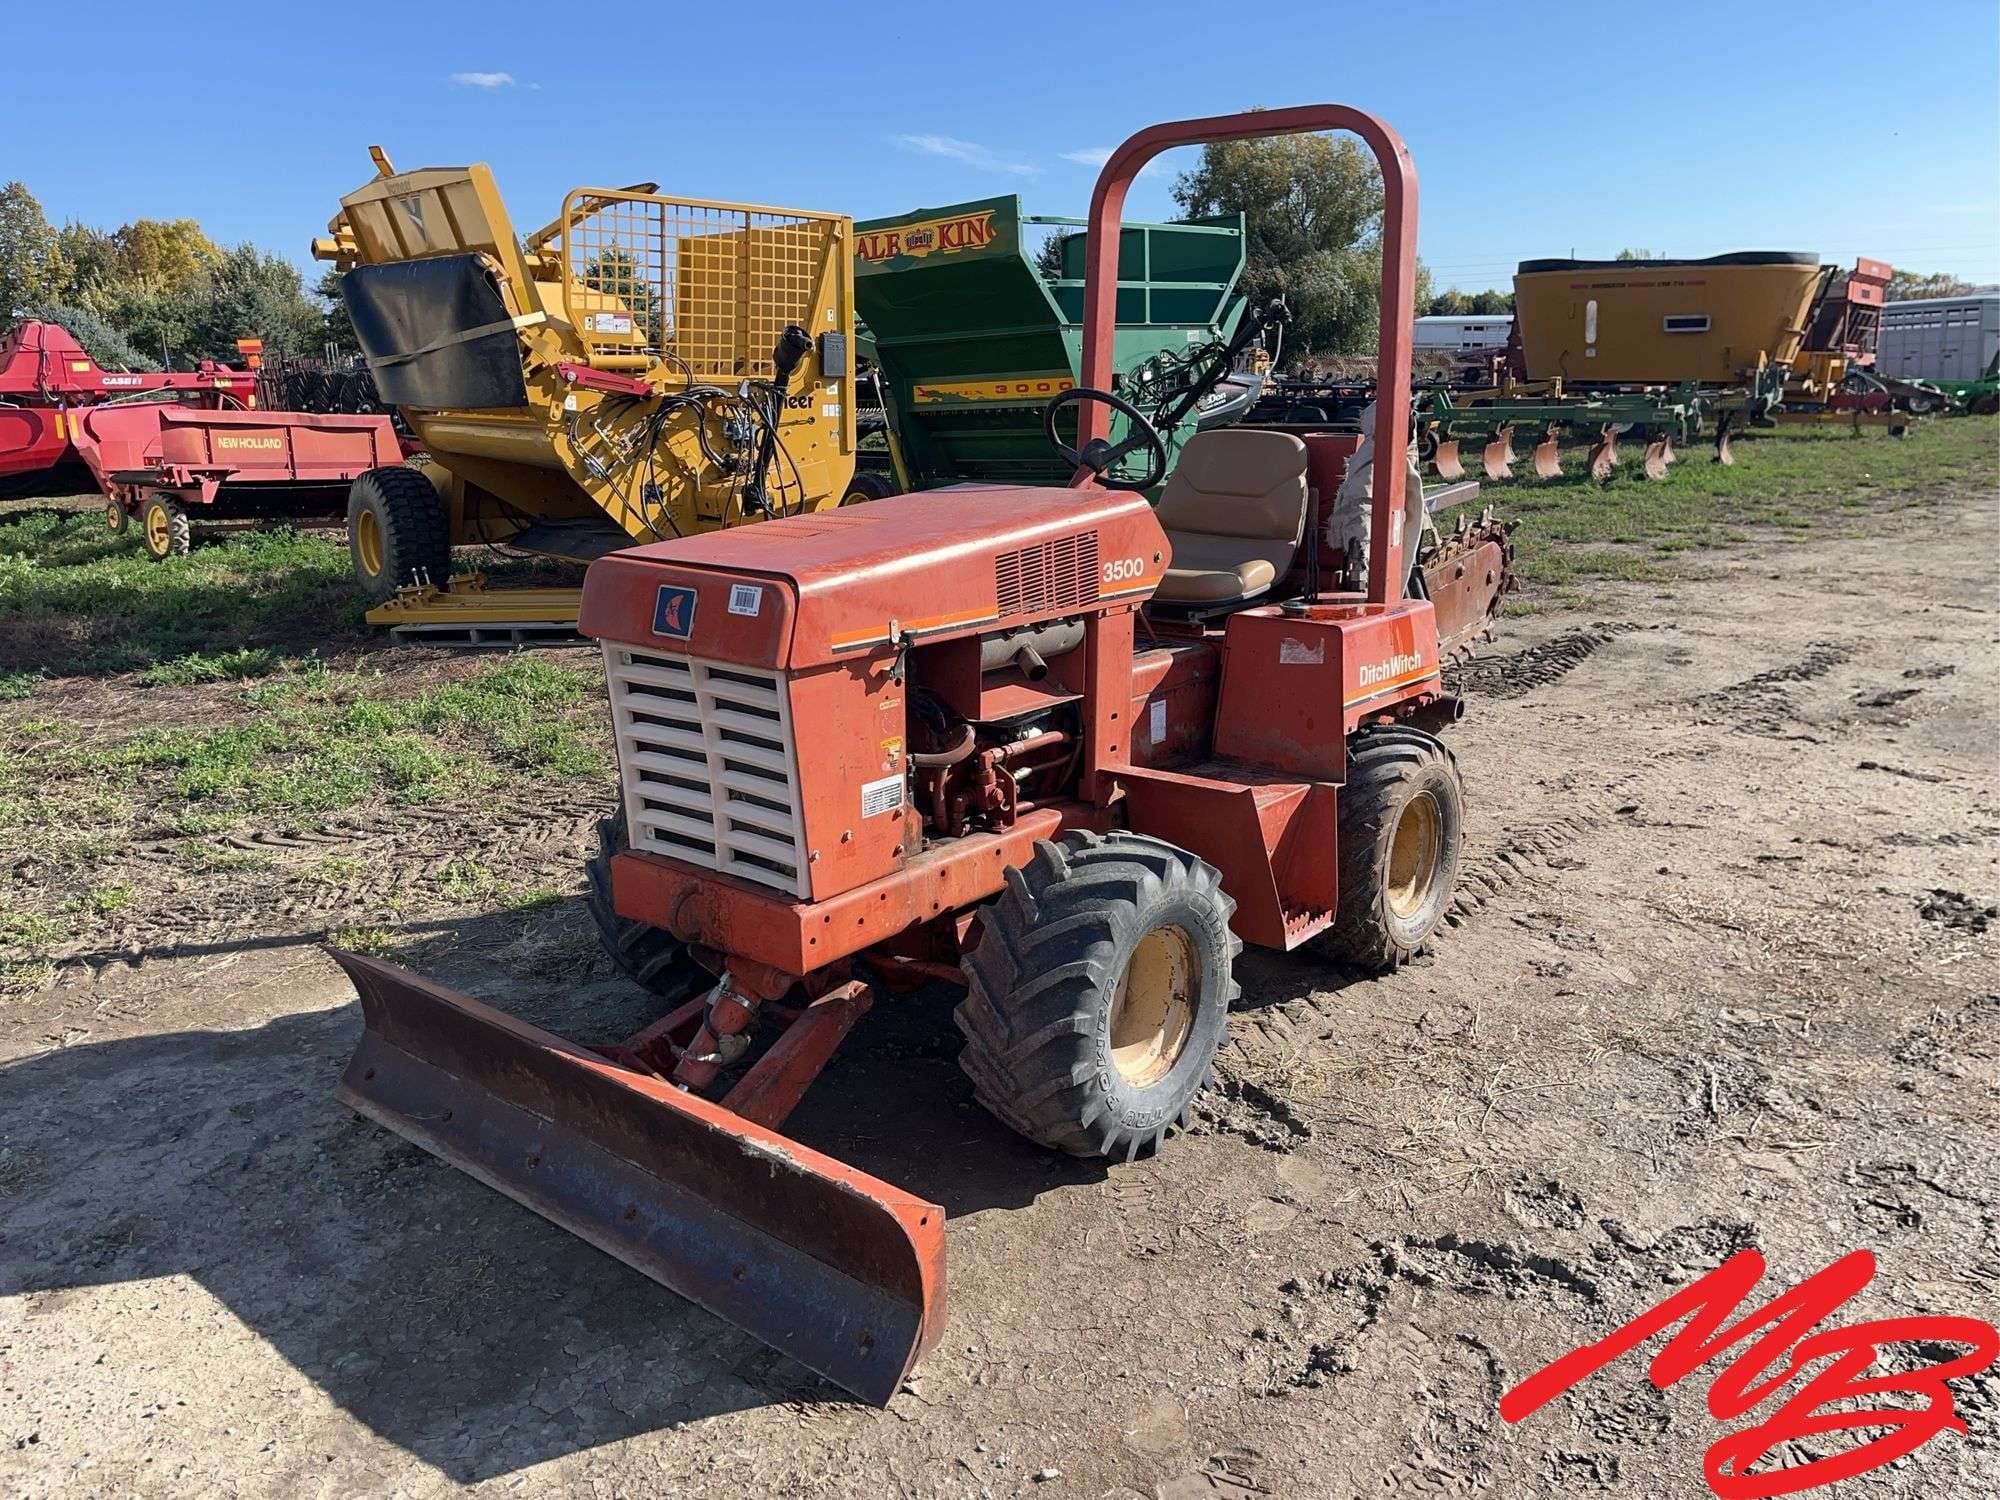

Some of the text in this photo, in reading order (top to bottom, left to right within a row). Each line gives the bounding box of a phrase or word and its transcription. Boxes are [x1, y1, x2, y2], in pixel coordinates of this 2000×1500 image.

[857, 232, 900, 259] ALE
[995, 381, 1073, 394] 3000
[218, 437, 282, 449] NEW HOLLAND
[1103, 557, 1144, 582] 3500
